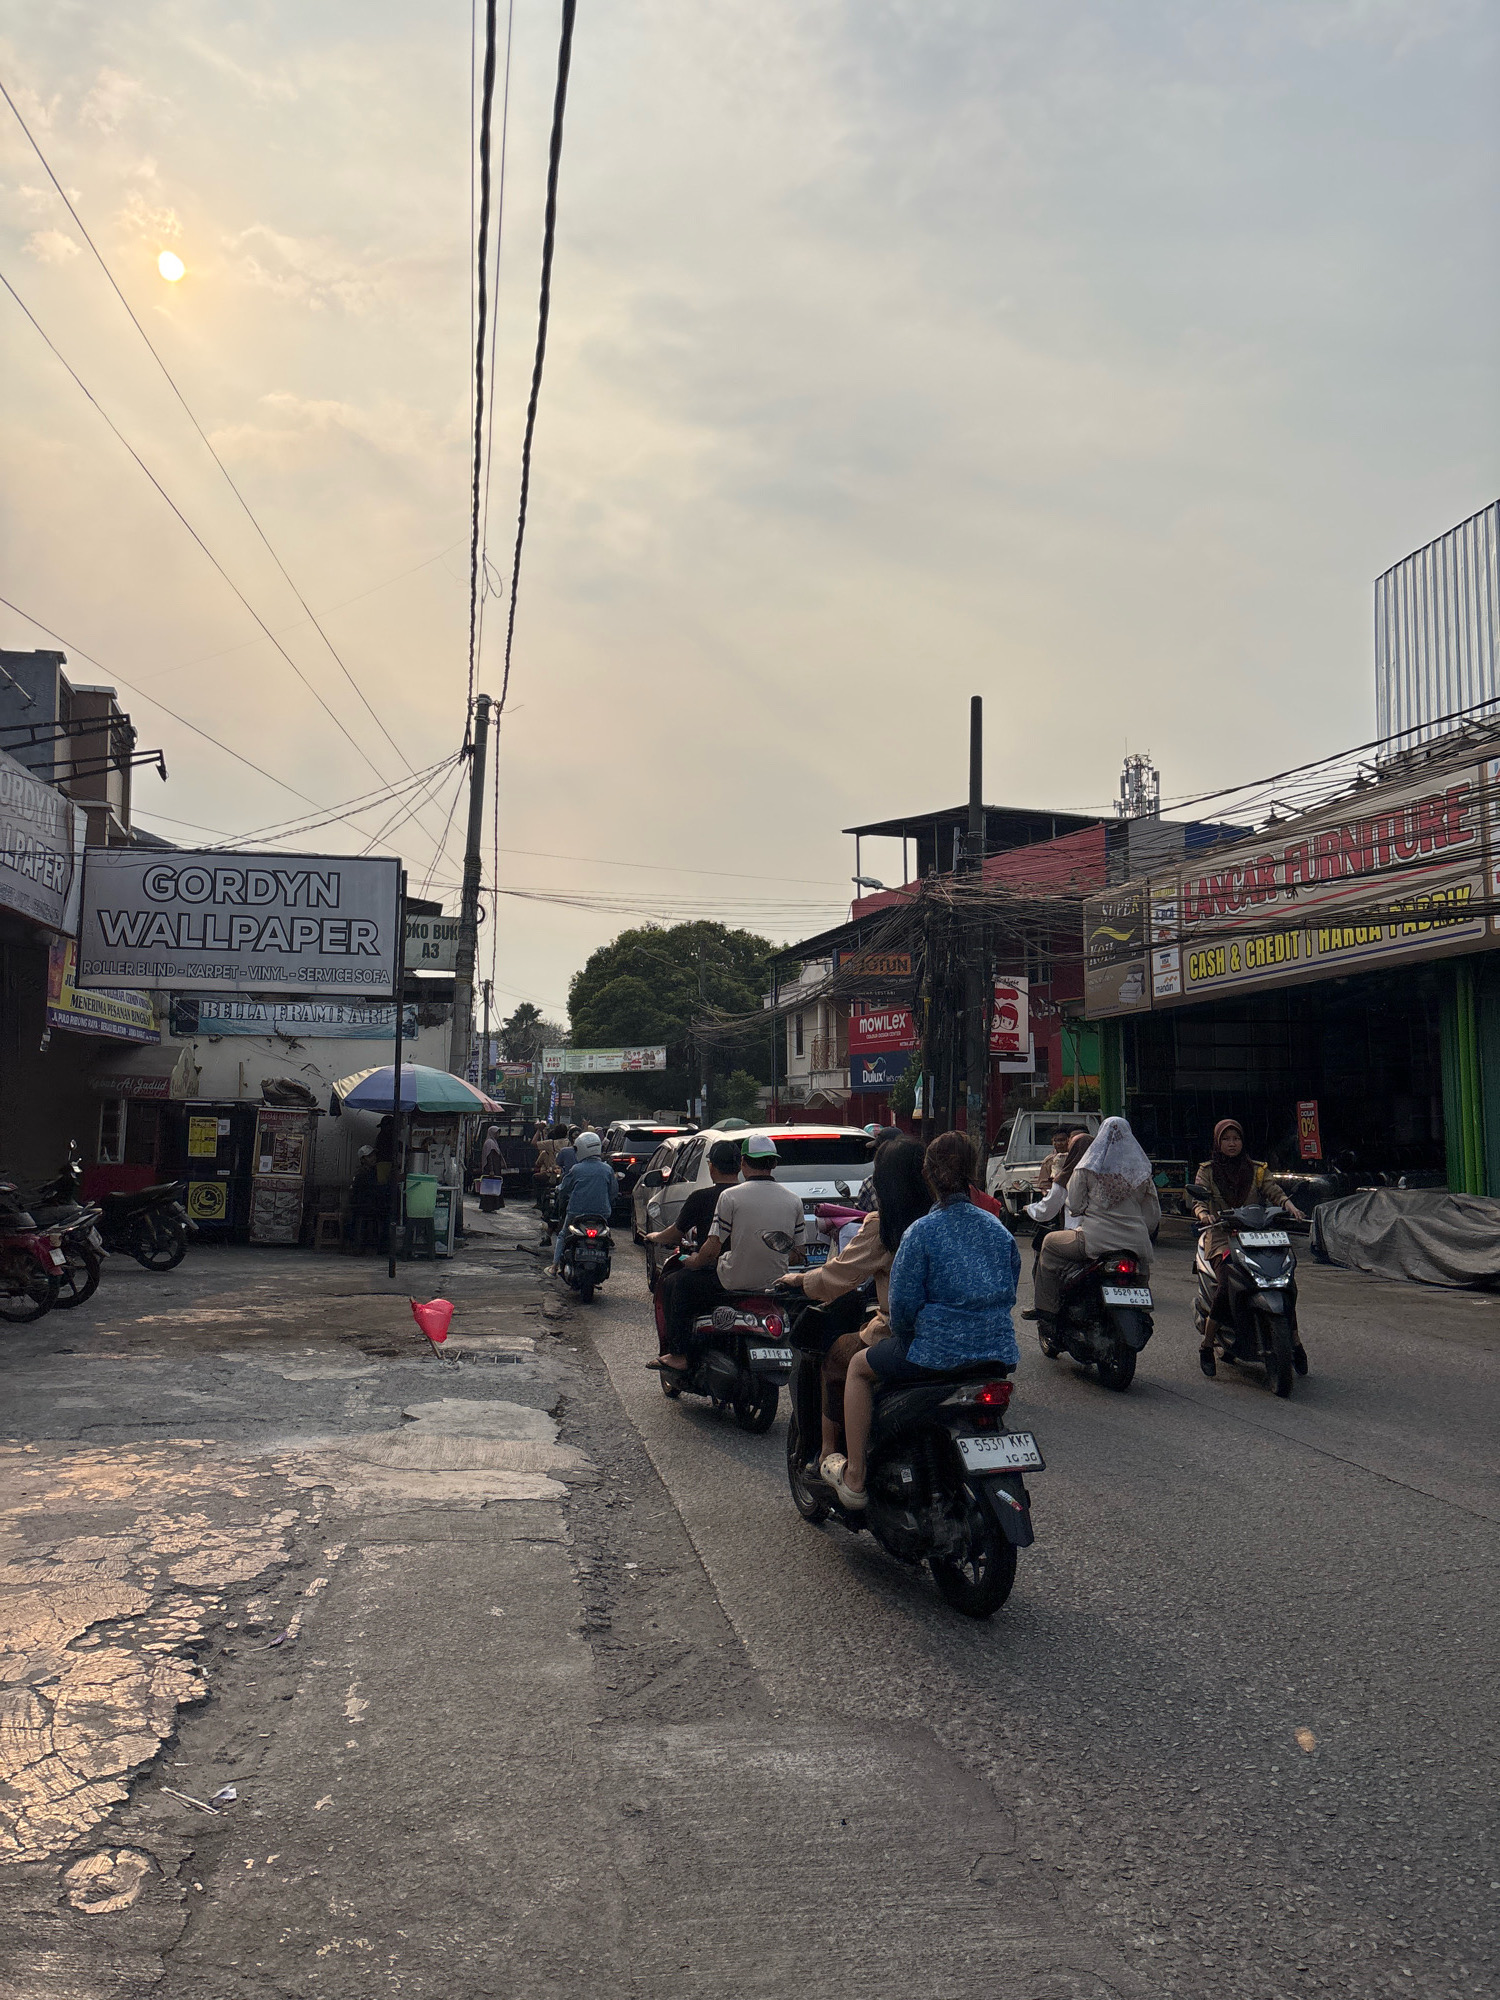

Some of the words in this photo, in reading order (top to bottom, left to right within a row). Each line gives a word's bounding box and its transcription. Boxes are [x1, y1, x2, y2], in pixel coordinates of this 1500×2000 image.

[0, 763, 58, 838] ORDYN
[0, 822, 65, 895] LPAPER
[1182, 853, 1279, 926] LANCAR
[1284, 780, 1477, 897] FURNITURE
[143, 865, 341, 908] GORDYN
[97, 909, 381, 955] WALLPAPER
[406, 923, 428, 939] OKO
[433, 925, 459, 941] BUK
[422, 943, 439, 958] A3
[1189, 946, 1226, 980] CASH
[1230, 943, 1241, 972] &
[1245, 930, 1300, 970] CREDIT
[1318, 918, 1383, 953] HARGA
[83, 960, 136, 976] ROLLER
[137, 962, 177, 977] BLIND
[187, 964, 239, 980] KARPET
[248, 965, 288, 981] VINYL
[298, 967, 352, 983] SERVICE
[355, 969, 390, 984] SOFA
[70, 994, 106, 1015] MENERIMA
[107, 1003, 131, 1021] PESANAN
[202, 1001, 267, 1020] BELLA
[273, 1003, 343, 1023] FRAME
[348, 1006, 393, 1025] ART
[116, 1077, 134, 1091] Al
[862, 1069, 883, 1083] Dulux
[1301, 1117, 1316, 1138] 0%
[752, 1351, 757, 1360] B
[960, 1441, 969, 1453] B
[1009, 1435, 1030, 1447] KKF
